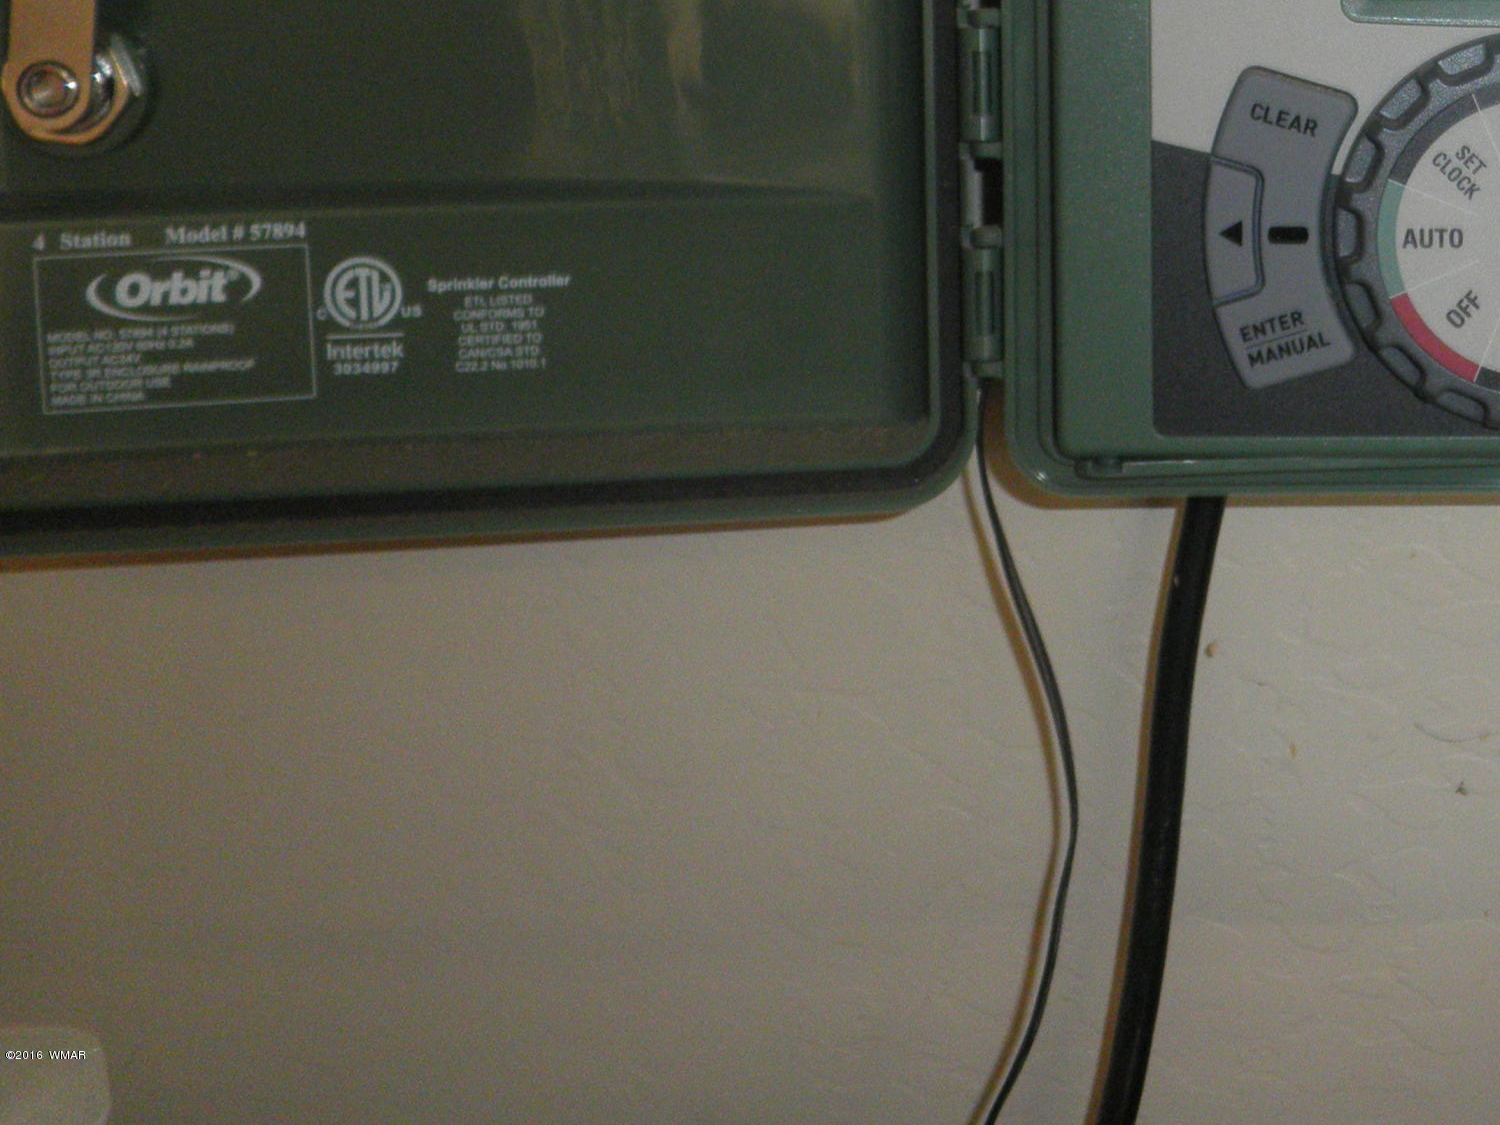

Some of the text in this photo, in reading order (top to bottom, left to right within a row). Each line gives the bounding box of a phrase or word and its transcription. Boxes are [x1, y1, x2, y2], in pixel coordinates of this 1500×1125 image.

[1250, 102, 1319, 137] CLEAR
[1431, 151, 1481, 201] CLOCK
[1455, 145, 1488, 175] SET
[59, 230, 132, 251] Station
[164, 225, 229, 246] Model
[250, 221, 306, 242] 57894
[1402, 228, 1464, 249] AUTO
[115, 270, 229, 309] Orbit
[427, 273, 572, 294] Sprinkler Controller
[1445, 289, 1482, 330] OFF
[1240, 310, 1305, 342] ENTER
[326, 340, 405, 361] Intertek
[1247, 332, 1332, 368] MANUAL
